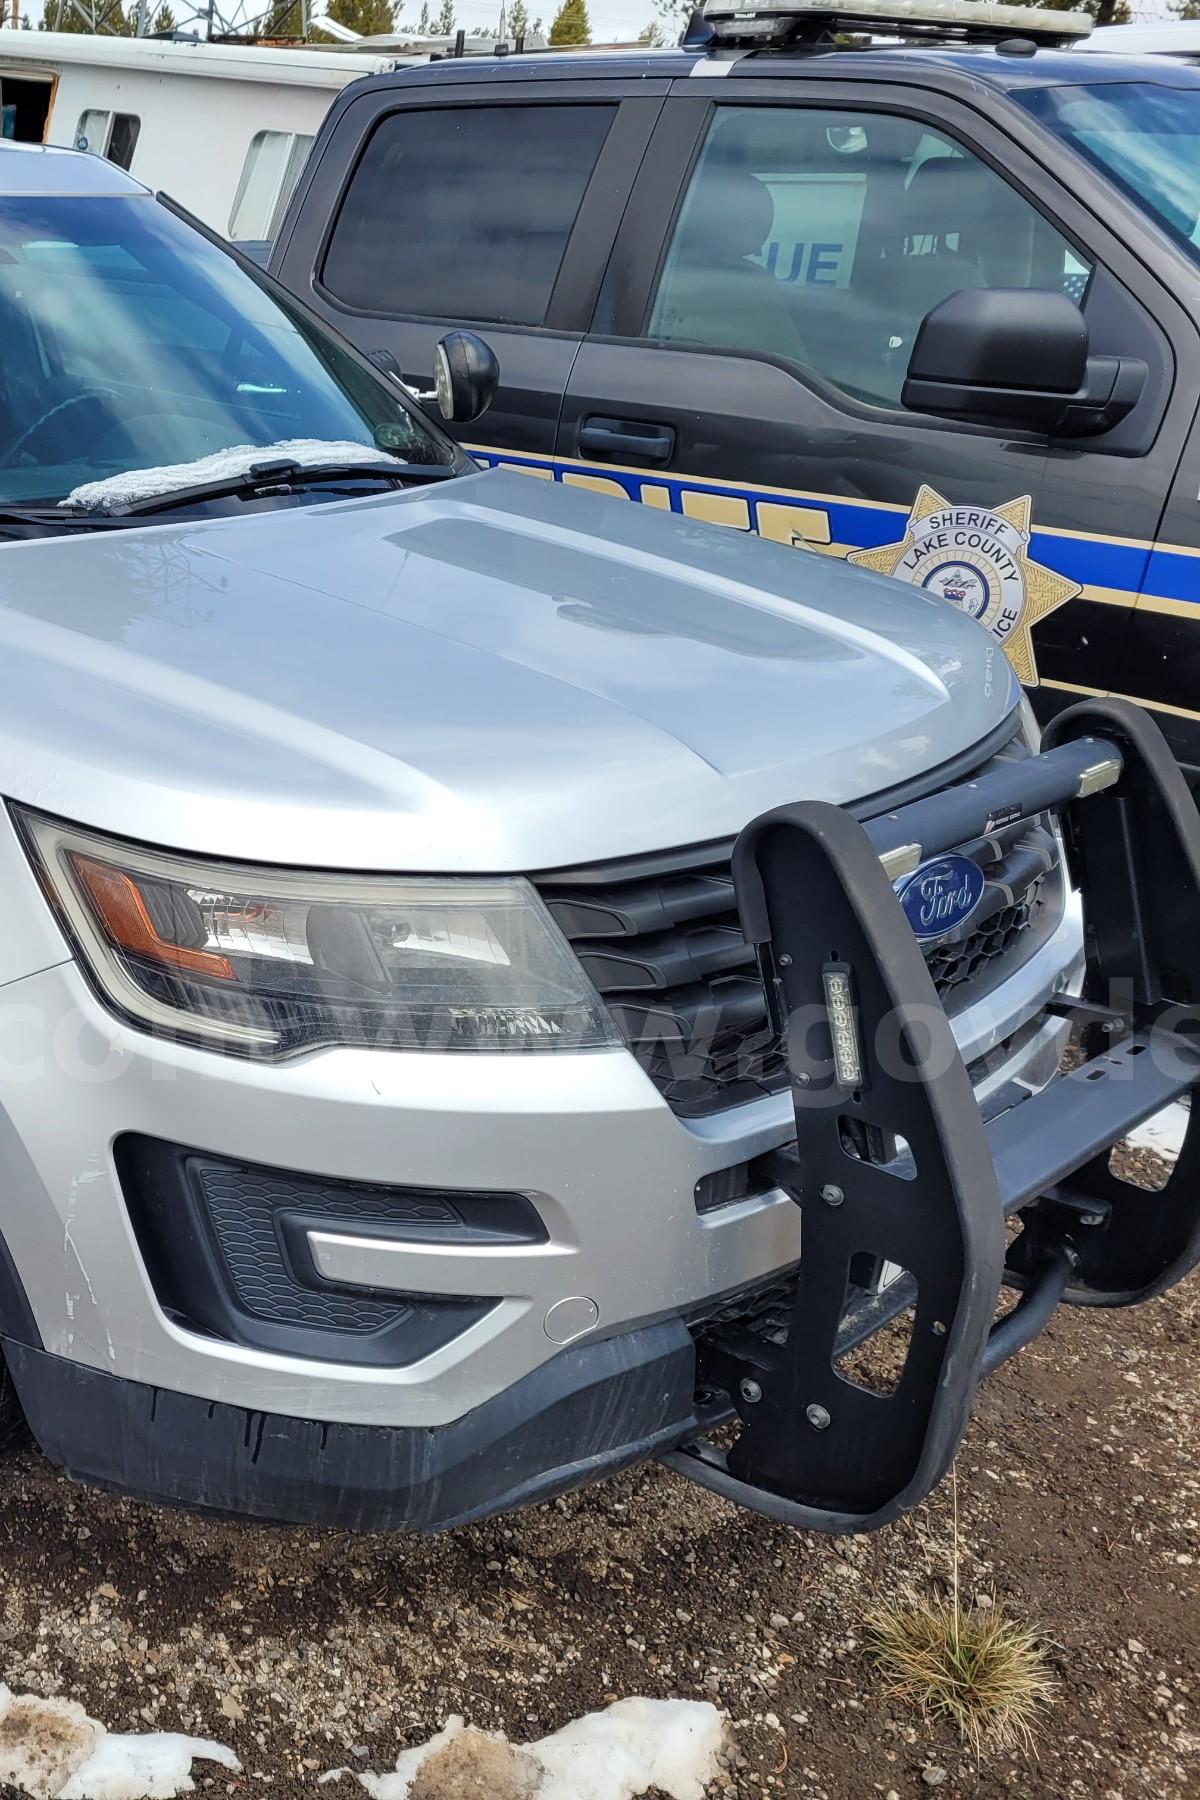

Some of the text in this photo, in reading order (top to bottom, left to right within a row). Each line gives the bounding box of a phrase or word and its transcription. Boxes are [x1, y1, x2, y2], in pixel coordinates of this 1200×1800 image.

[928, 511, 1009, 536] SHERIFF
[903, 531, 1019, 582] LAKE COUNTY
[919, 869, 972, 927] Ford
